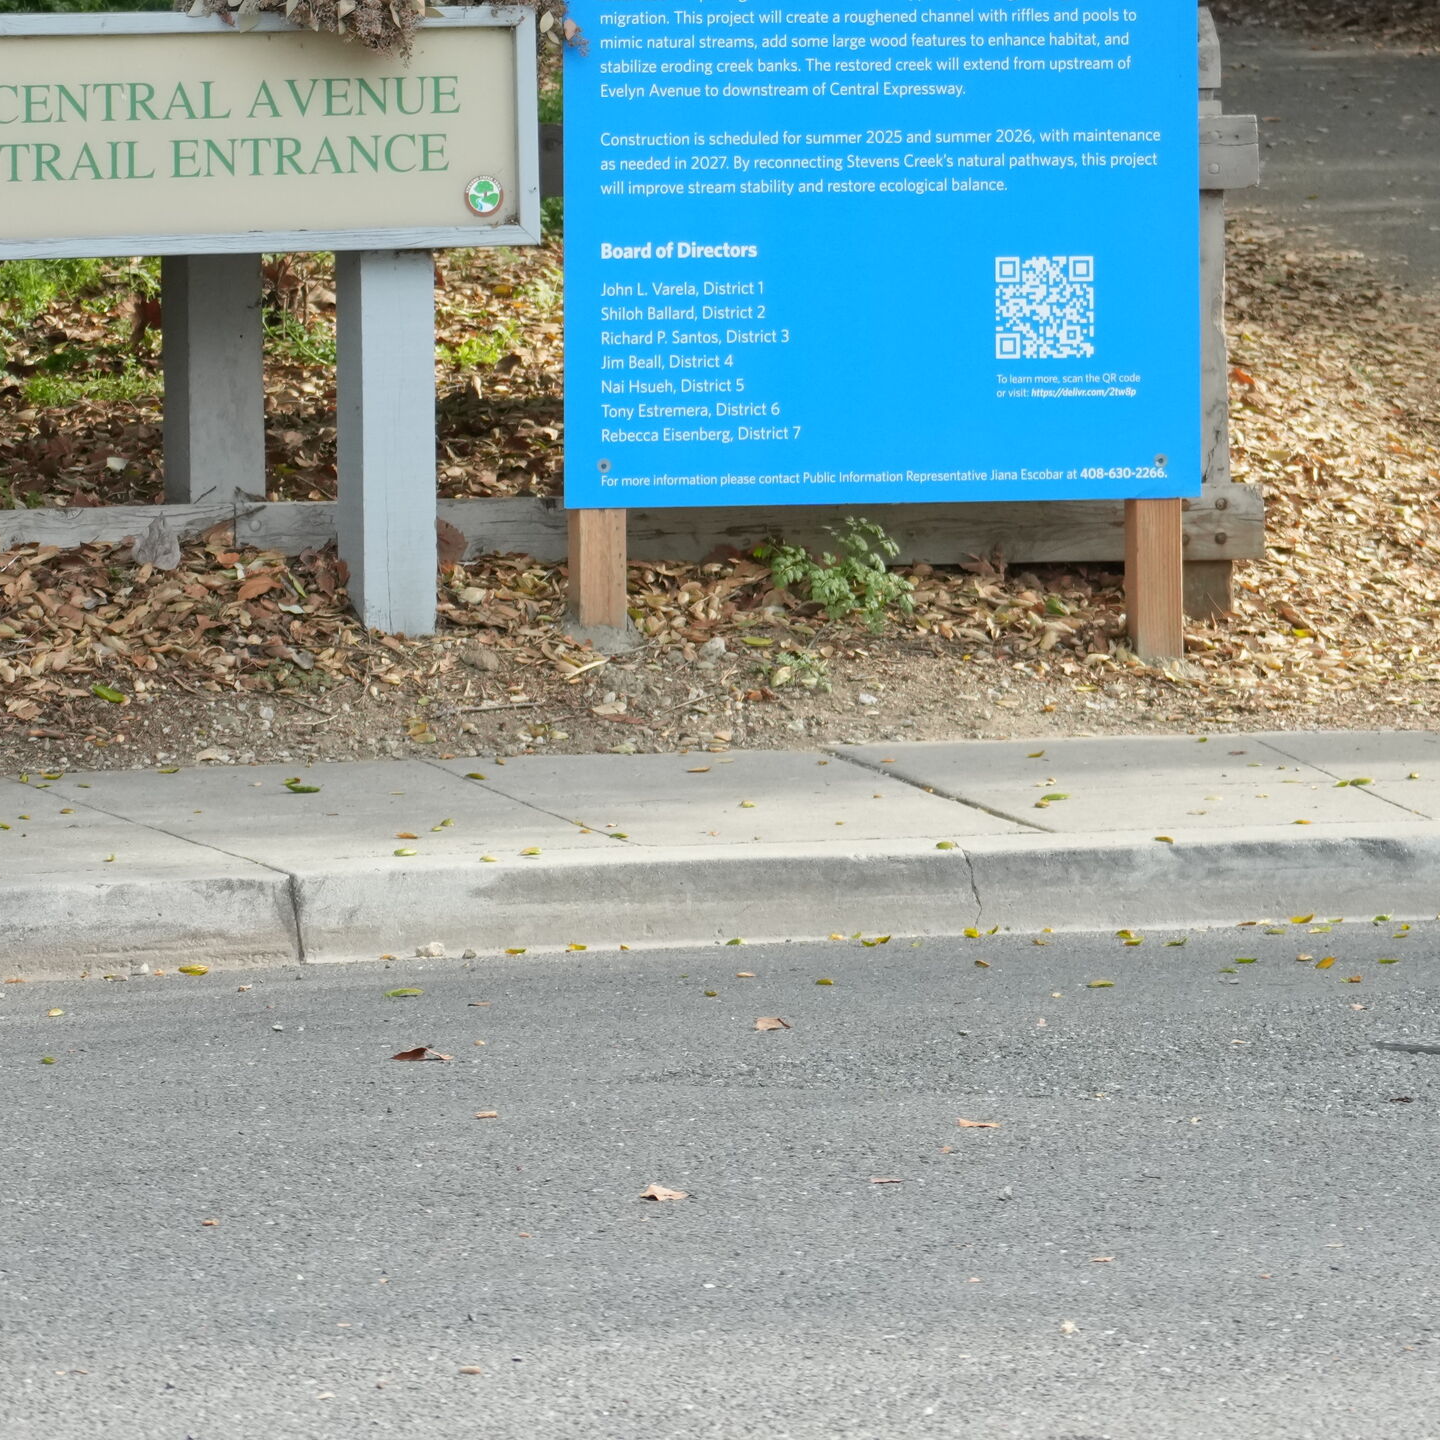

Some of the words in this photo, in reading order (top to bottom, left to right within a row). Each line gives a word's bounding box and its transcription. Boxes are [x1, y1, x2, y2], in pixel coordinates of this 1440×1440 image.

[247, 75, 460, 118] AVENUE
[600, 84, 645, 100] Evelyn
[648, 84, 701, 97] Avenue
[703, 84, 719, 96] to
[721, 82, 808, 96] downstream
[811, 82, 826, 96] of
[829, 82, 879, 96] Central
[882, 81, 965, 98] Expressway.
[599, 132, 690, 146] Construction
[693, 132, 705, 145] is
[708, 131, 779, 145] scheduled
[781, 131, 802, 144] for
[805, 134, 862, 144] summer
[865, 130, 903, 144] 2025
[905, 130, 932, 143] and
[934, 132, 992, 143] summer
[995, 129, 1035, 144] 2026,
[1039, 128, 1070, 142] with
[1072, 128, 1161, 142] maintenance
[170, 133, 450, 179] ENTRANCE
[599, 160, 616, 170] as
[619, 156, 672, 170] needed
[673, 157, 687, 169] in
[690, 156, 729, 170] 2027.
[733, 155, 750, 172] By
[753, 155, 843, 171] reconnecting
[846, 154, 900, 168] Stevens
[957, 153, 1006, 167] natural
[1008, 153, 1077, 169] pathways,
[1080, 152, 1106, 166] this
[1109, 152, 1157, 168] project
[599, 181, 624, 194] will
[627, 181, 684, 197] improve
[687, 181, 736, 194] stream
[739, 179, 794, 195] stability
[797, 179, 824, 192] and
[827, 180, 876, 192] restore
[878, 178, 948, 194] ecological
[951, 177, 1007, 191] balance.
[600, 242, 652, 259] Board
[654, 241, 674, 259] of
[676, 241, 758, 258] Directors
[600, 283, 633, 296] John
[636, 283, 648, 296] L.
[651, 282, 699, 296] Varela,
[703, 281, 754, 295] District
[757, 281, 763, 294] 1
[600, 306, 644, 321] Shiloh
[647, 306, 697, 321] Ballard,
[701, 305, 753, 319] District
[756, 305, 765, 319] 2
[600, 330, 654, 345] Richard
[656, 330, 667, 344] P.
[671, 330, 722, 345] Santos,
[725, 329, 777, 343] District
[780, 329, 790, 343] 3
[600, 356, 624, 369] Jim
[628, 355, 664, 370] Beall,
[668, 354, 720, 368] District
[723, 354, 734, 367] 4
[600, 380, 624, 393] Nai
[628, 379, 676, 394] Hsueh,
[680, 378, 732, 392] District
[735, 378, 744, 392] 5
[996, 374, 1007, 383] To
[1009, 375, 1032, 384] learn
[1085, 374, 1100, 382] the
[1101, 373, 1116, 384] QR
[1118, 373, 1140, 382] code
[1008, 389, 1028, 397] visit:
[600, 404, 634, 420] Tony
[637, 404, 711, 418] Estremera,
[715, 402, 766, 416] District
[770, 402, 780, 415] 6
[601, 429, 659, 442] Rebecca
[662, 427, 733, 443] Eisenberg,
[737, 426, 788, 440] District
[792, 426, 801, 439] 7
[601, 475, 618, 486] For
[621, 477, 650, 486] more
[653, 474, 717, 485] information
[720, 474, 756, 487] please
[758, 473, 800, 484] contact
[802, 472, 835, 483] Public
[839, 471, 903, 482] Information
[905, 470, 987, 483] Representative
[990, 470, 1017, 480] Jiana
[1020, 468, 1063, 480] Escobar
[1066, 469, 1077, 480] at
[1079, 466, 1167, 479] 408-630-2266.
